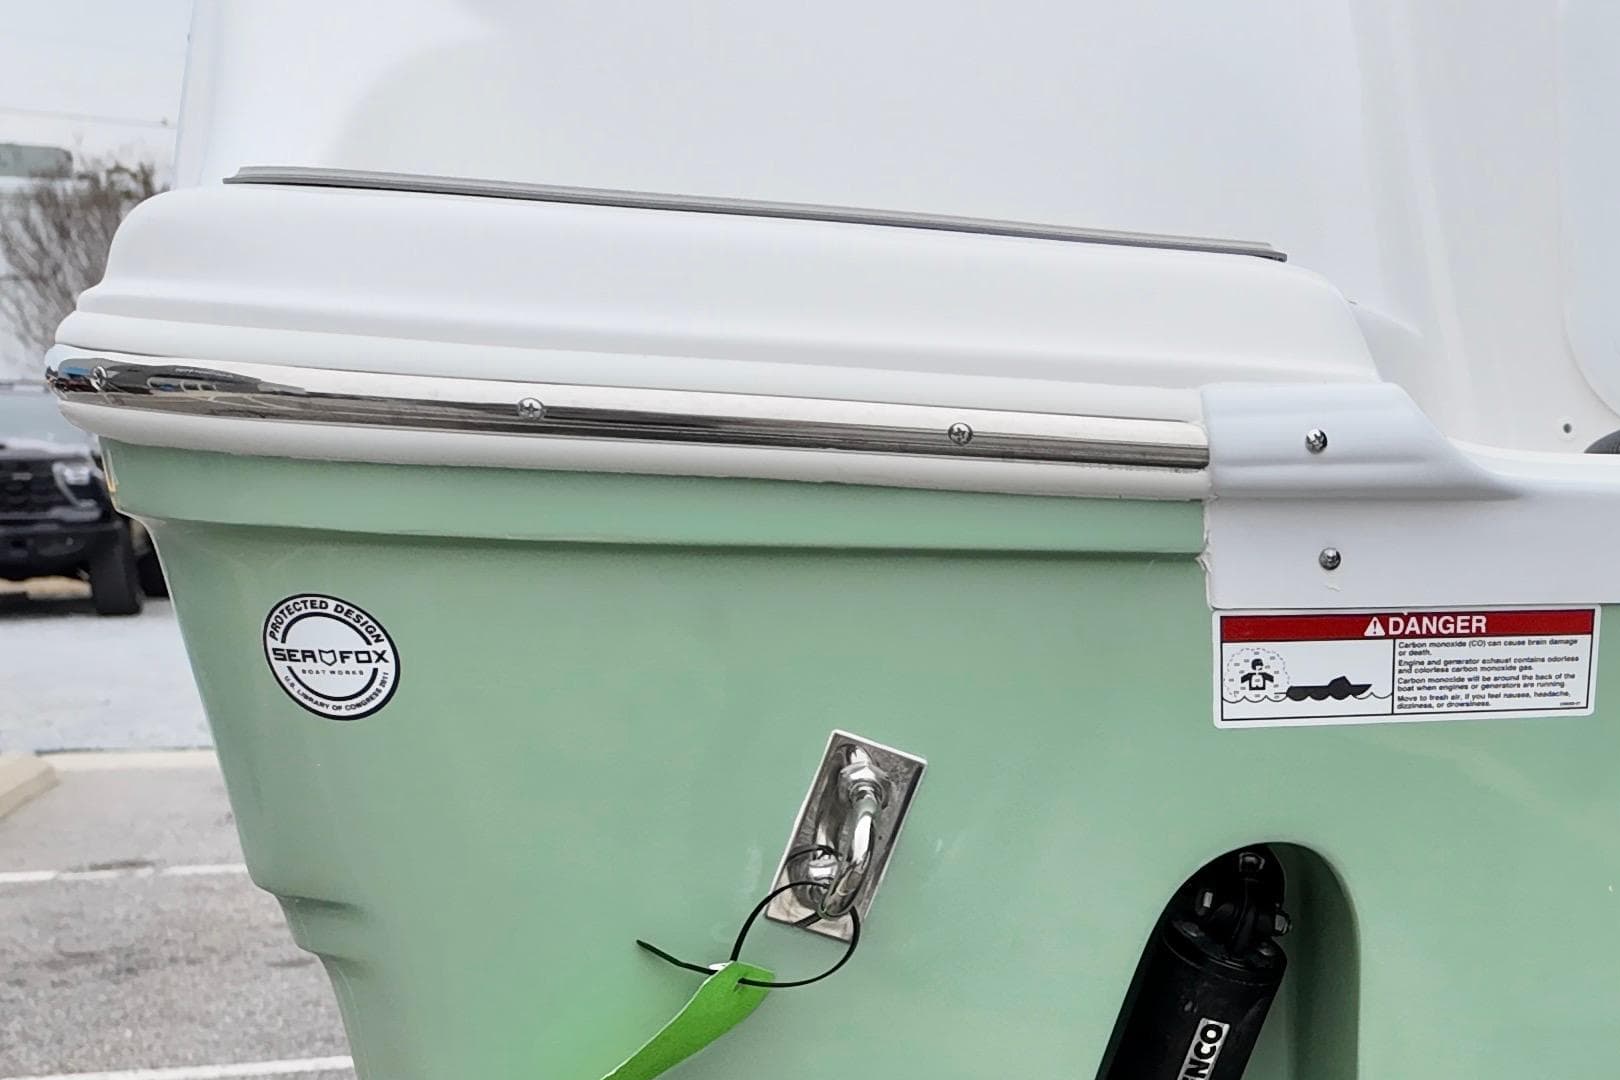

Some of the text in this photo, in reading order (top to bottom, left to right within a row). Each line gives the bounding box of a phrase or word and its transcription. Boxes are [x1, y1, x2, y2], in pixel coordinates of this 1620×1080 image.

[269, 599, 385, 643] PROTECTED DESIGN
[1388, 615, 1487, 635] DANGER
[1398, 641, 1427, 649] Carbon
[1429, 640, 1467, 648] monoxide
[1468, 639, 1486, 648] (CO)
[1503, 639, 1526, 647] cause
[1527, 638, 1547, 646] brain
[1548, 637, 1578, 647] damage
[272, 648, 389, 664] SEA FOX
[1398, 660, 1425, 668] Engine
[1443, 659, 1479, 667] generator
[1398, 666, 1412, 674] and
[1414, 666, 1449, 674] colorless
[1451, 665, 1478, 673] carbon
[1479, 664, 1517, 672] monoxide
[1397, 677, 1426, 685] Carbon
[1438, 683, 1468, 691] engines
[1480, 682, 1521, 690] generators
[1429, 693, 1448, 701] fresh
